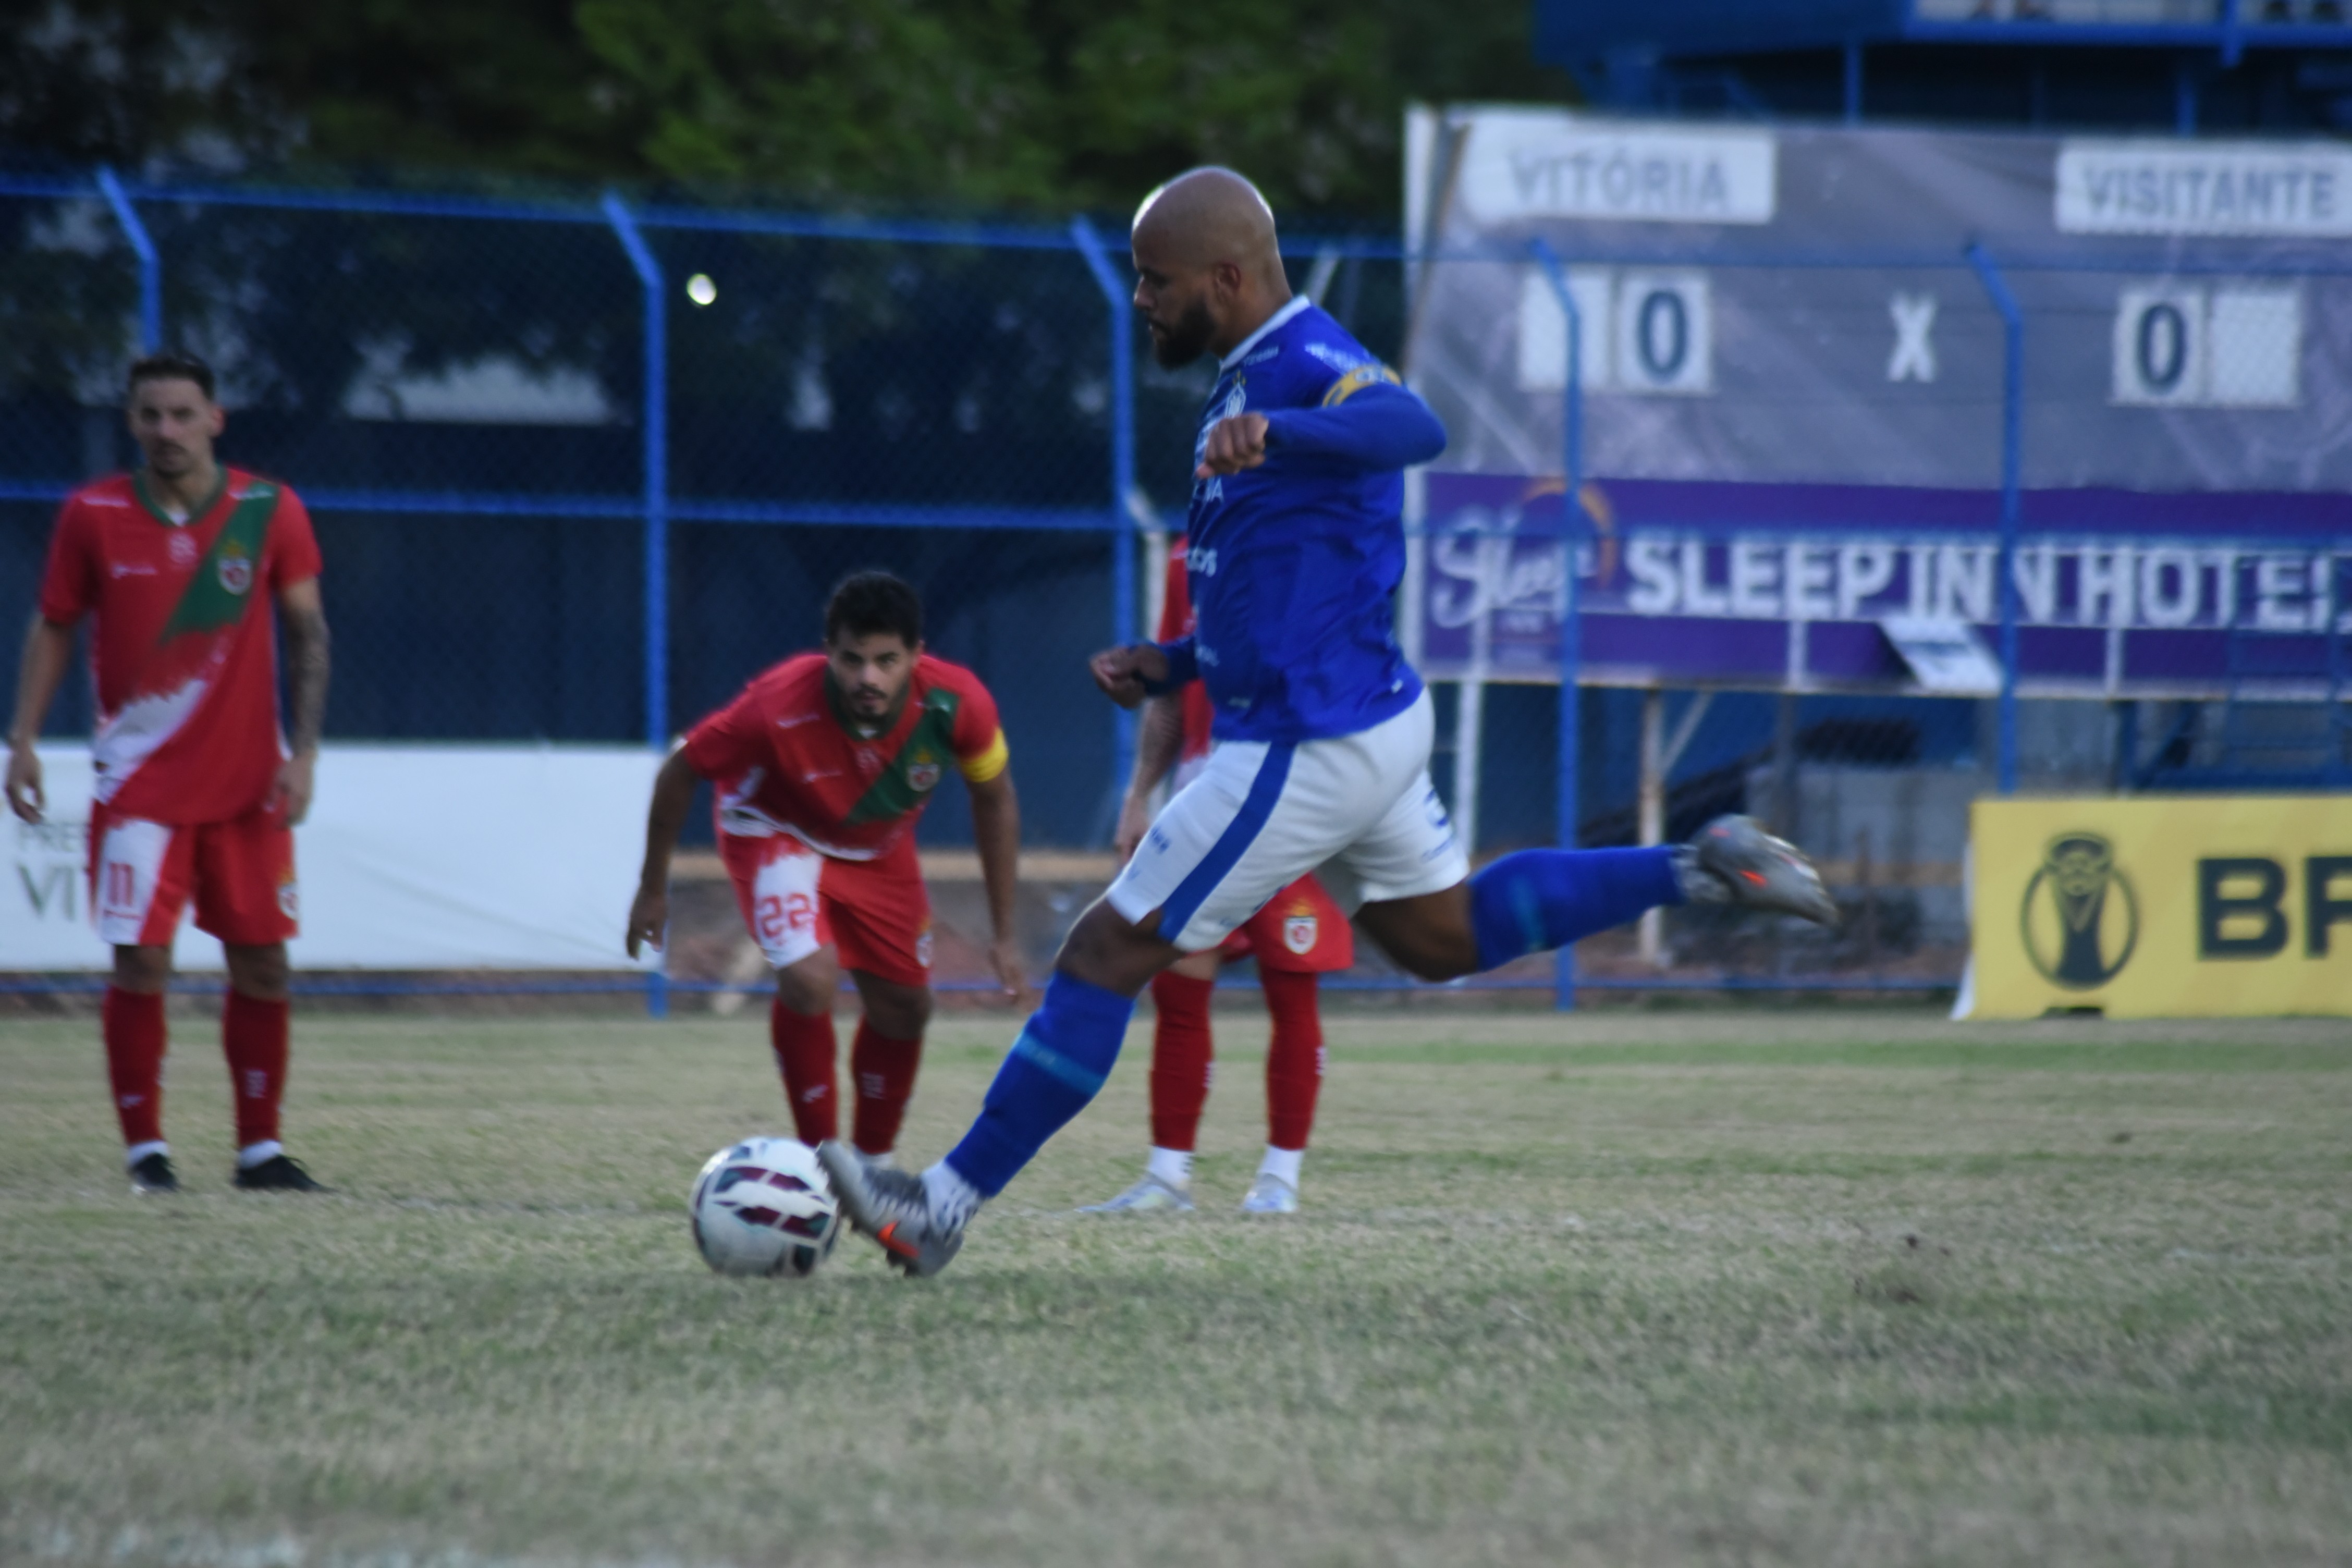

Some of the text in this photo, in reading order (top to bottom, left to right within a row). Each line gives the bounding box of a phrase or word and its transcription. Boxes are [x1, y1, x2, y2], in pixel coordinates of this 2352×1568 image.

[1511, 146, 1729, 209] VITÓRIA
[2083, 165, 2335, 215] VISITANTE
[1637, 290, 1689, 383] 0
[2136, 302, 2187, 394] 0
[1624, 531, 1897, 619] SLEEP
[16, 862, 91, 922] VI
[107, 861, 134, 908] 11
[759, 892, 812, 938] 22
